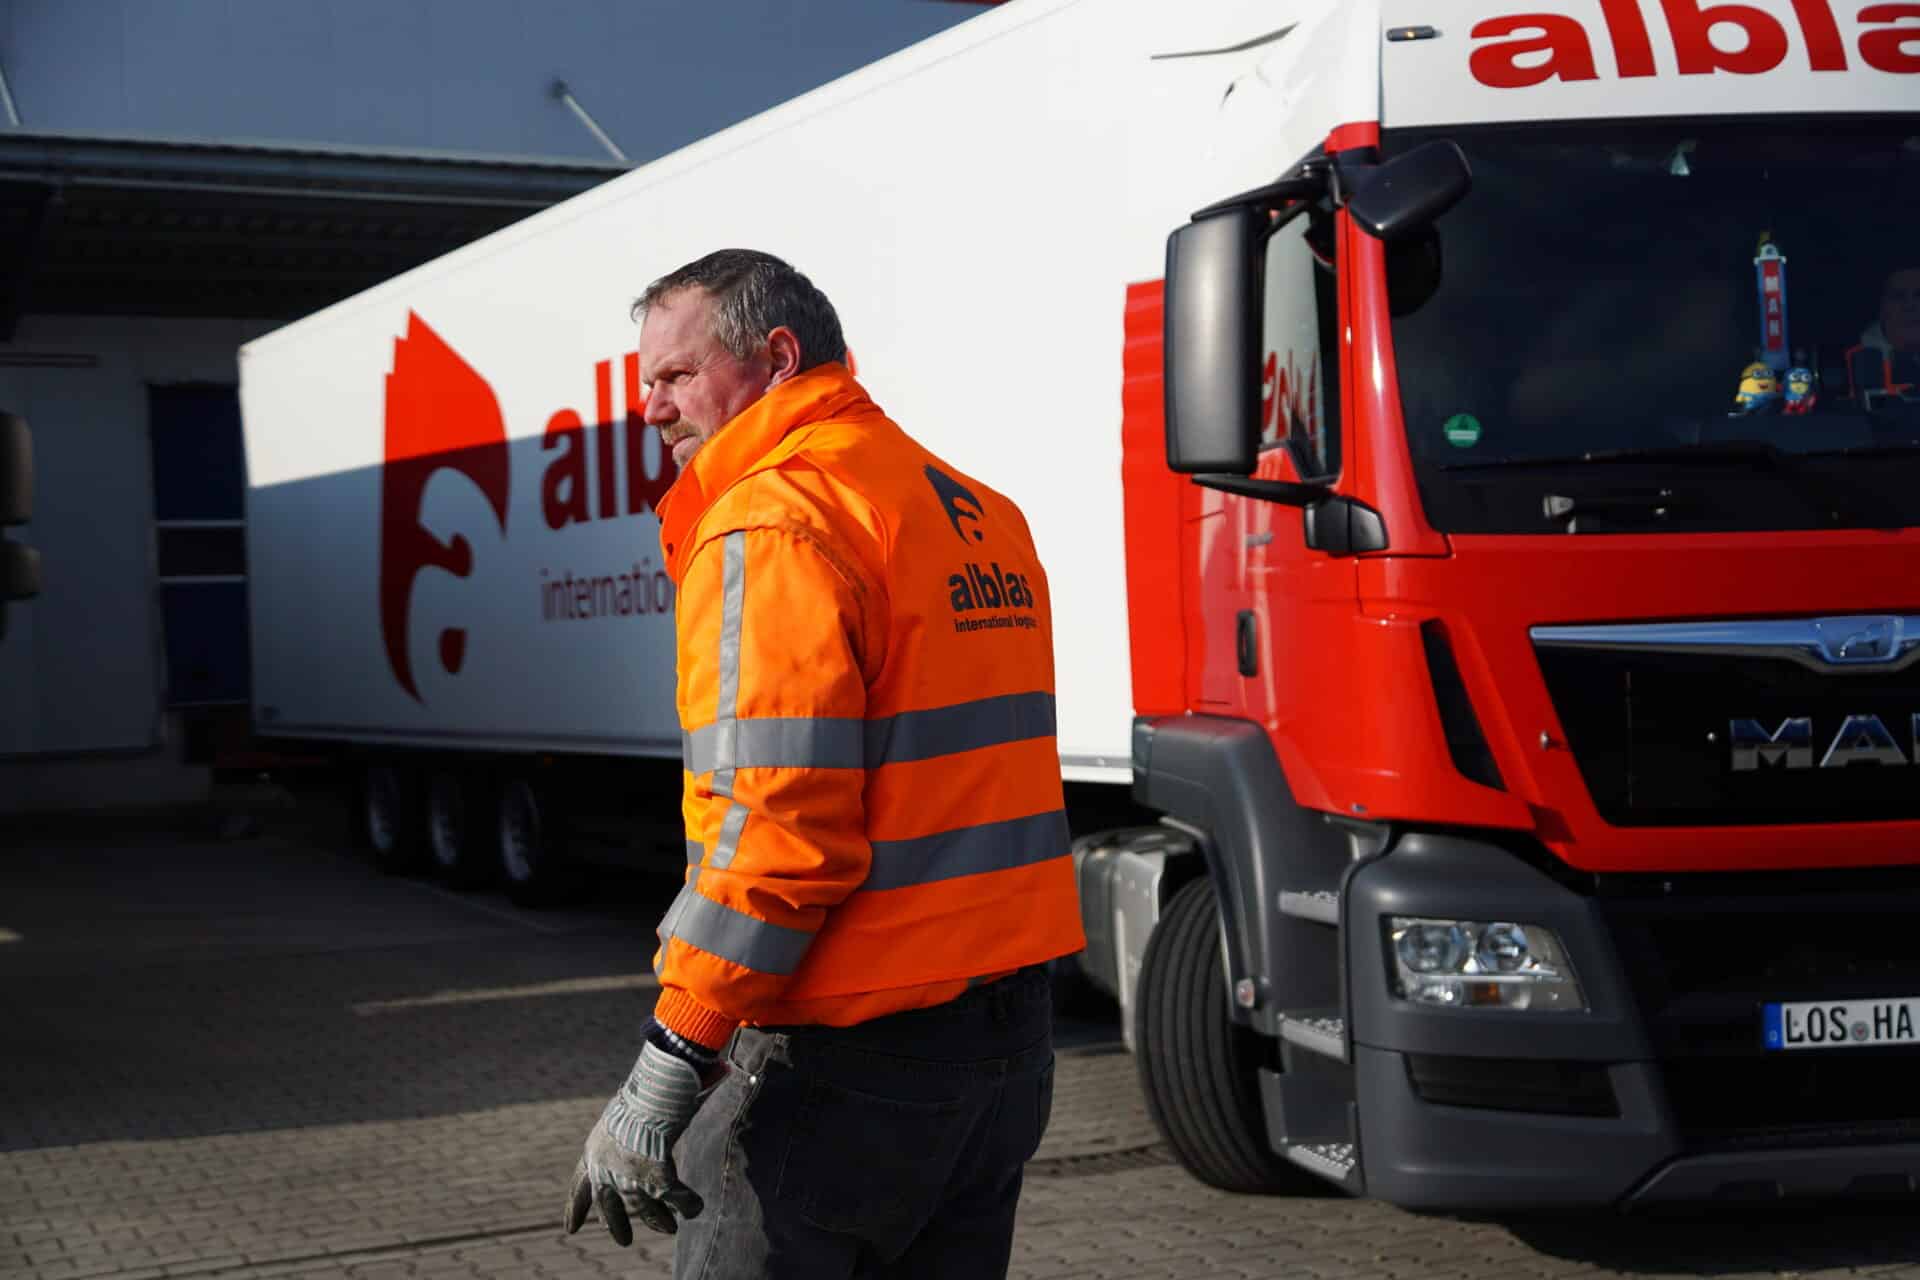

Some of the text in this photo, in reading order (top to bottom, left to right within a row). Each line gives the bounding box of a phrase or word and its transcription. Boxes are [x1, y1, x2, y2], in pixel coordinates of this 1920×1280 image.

[1729, 712, 1920, 771] MA
[1785, 1006, 1848, 1044] LOS
[1873, 1003, 1914, 1040] HA
